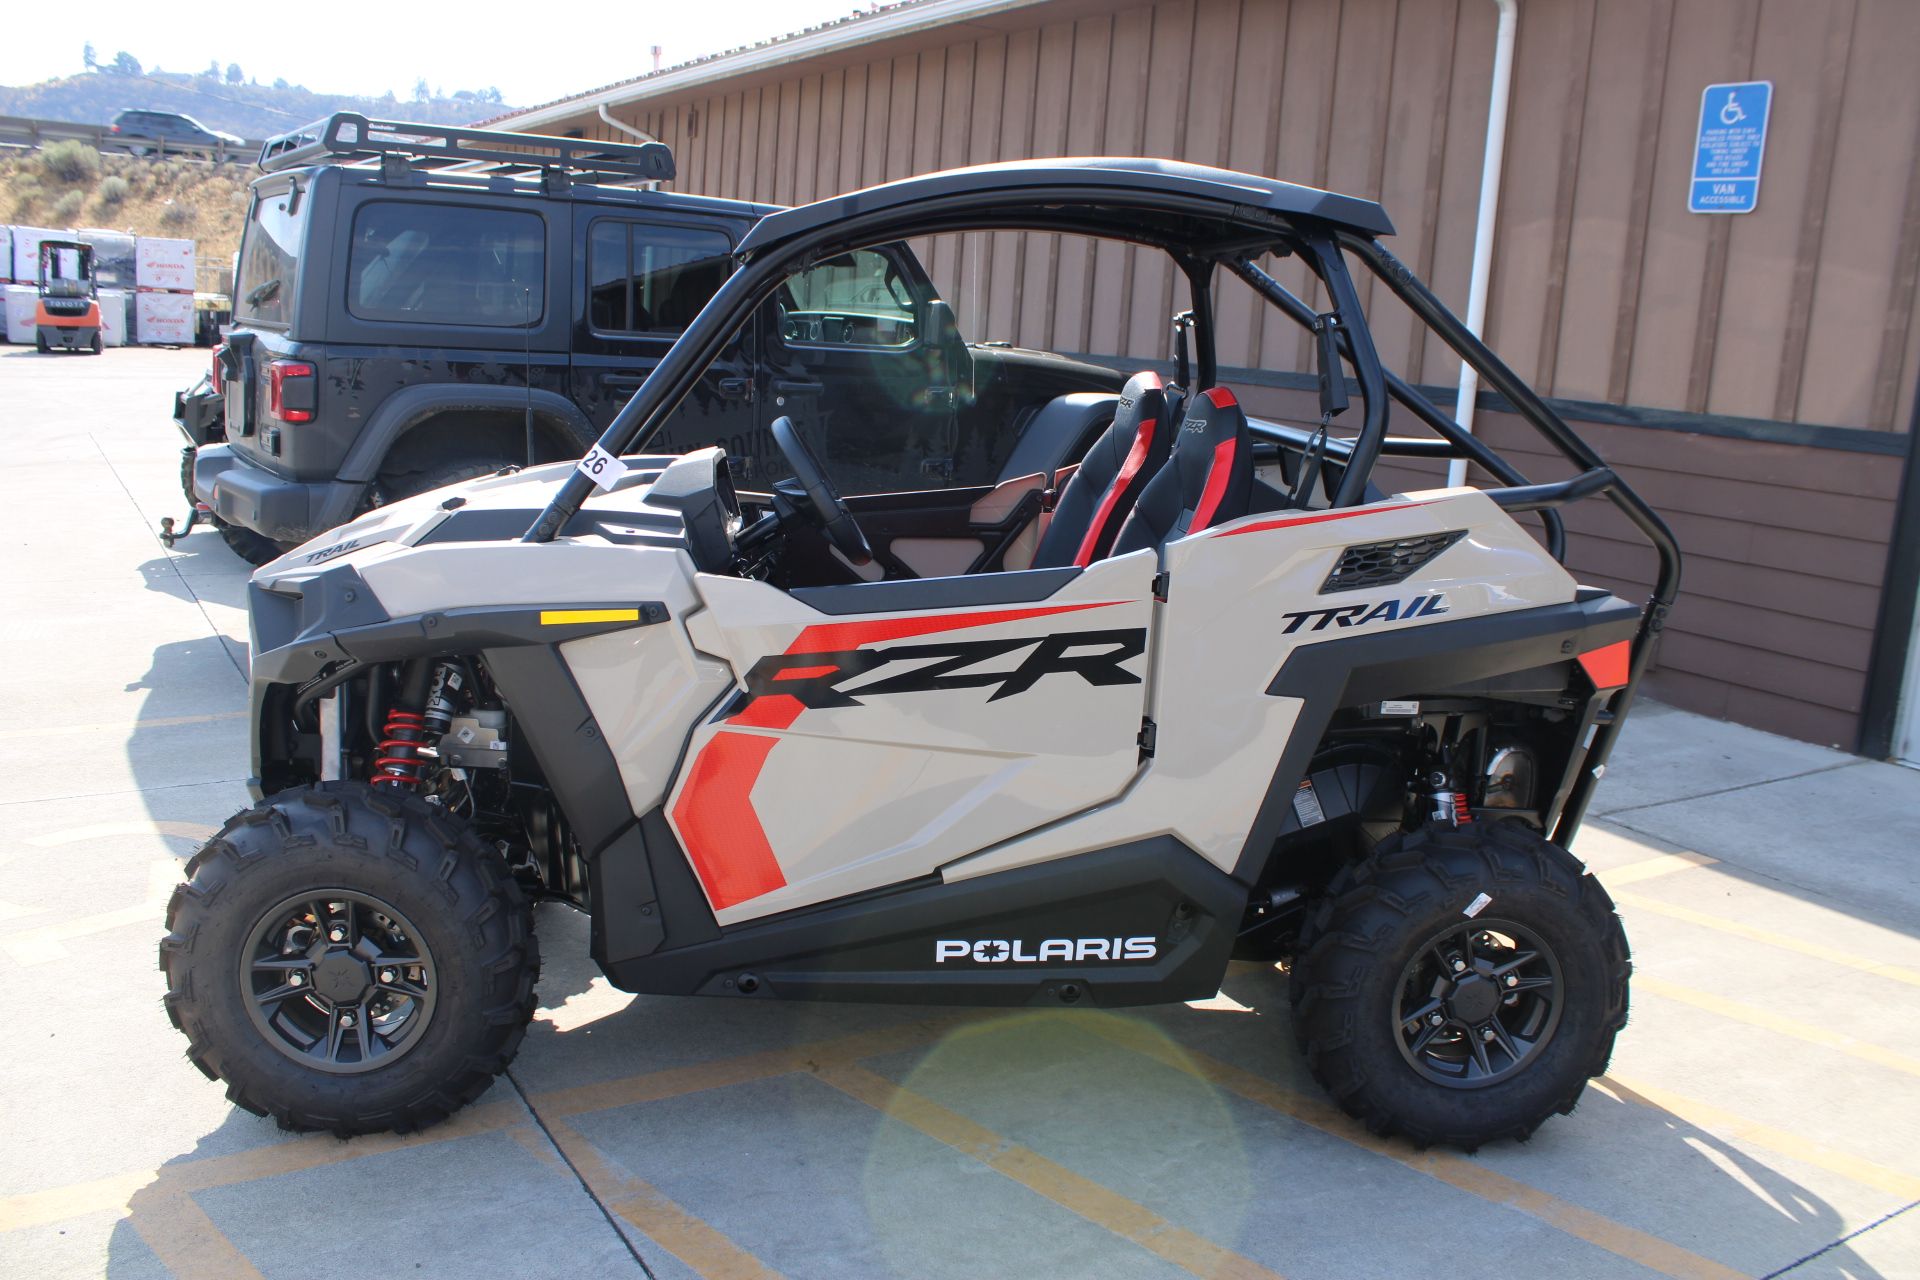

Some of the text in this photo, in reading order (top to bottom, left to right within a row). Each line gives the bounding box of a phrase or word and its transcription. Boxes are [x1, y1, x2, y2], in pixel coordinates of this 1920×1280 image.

[1699, 195, 1746, 204] ACCESSIBLE
[1713, 184, 1736, 194] VAN
[582, 449, 608, 475] 26
[306, 539, 360, 563] TRAIL
[1281, 593, 1451, 635] TRAIL
[707, 627, 1148, 724] RZR
[935, 936, 1157, 963] POLARIS
